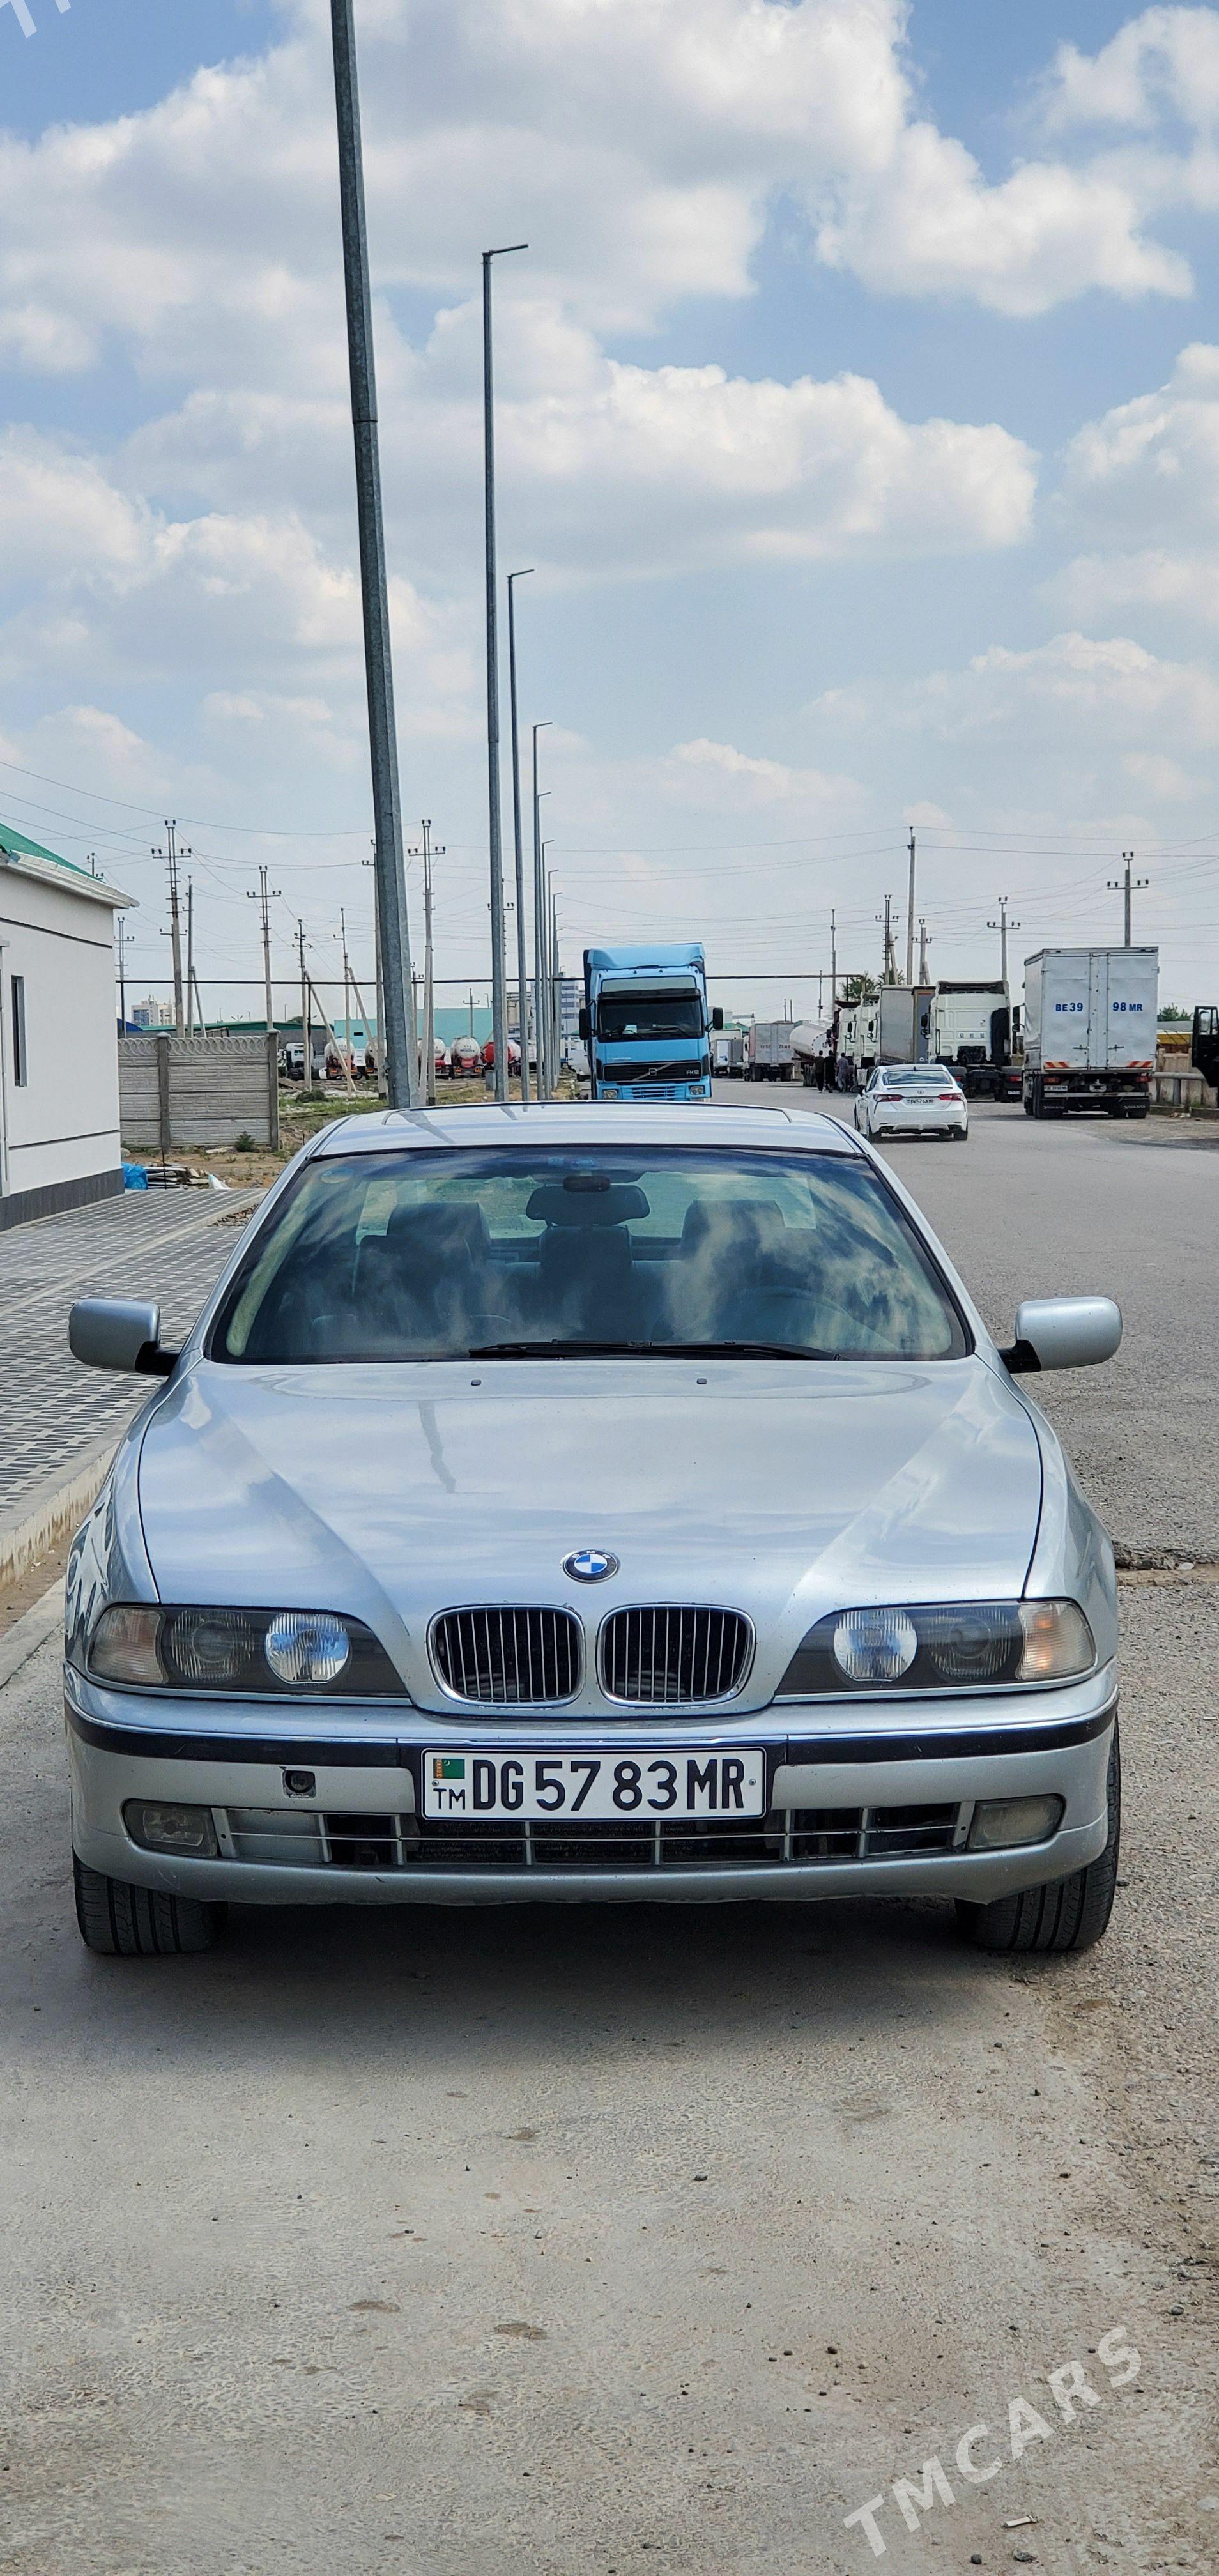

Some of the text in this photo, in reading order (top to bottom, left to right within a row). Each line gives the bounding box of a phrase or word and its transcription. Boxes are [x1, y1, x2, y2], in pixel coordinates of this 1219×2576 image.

[1112, 1002, 1126, 1011] 98
[571, 1550, 611, 1560] BMW
[433, 1788, 466, 1810] TM
